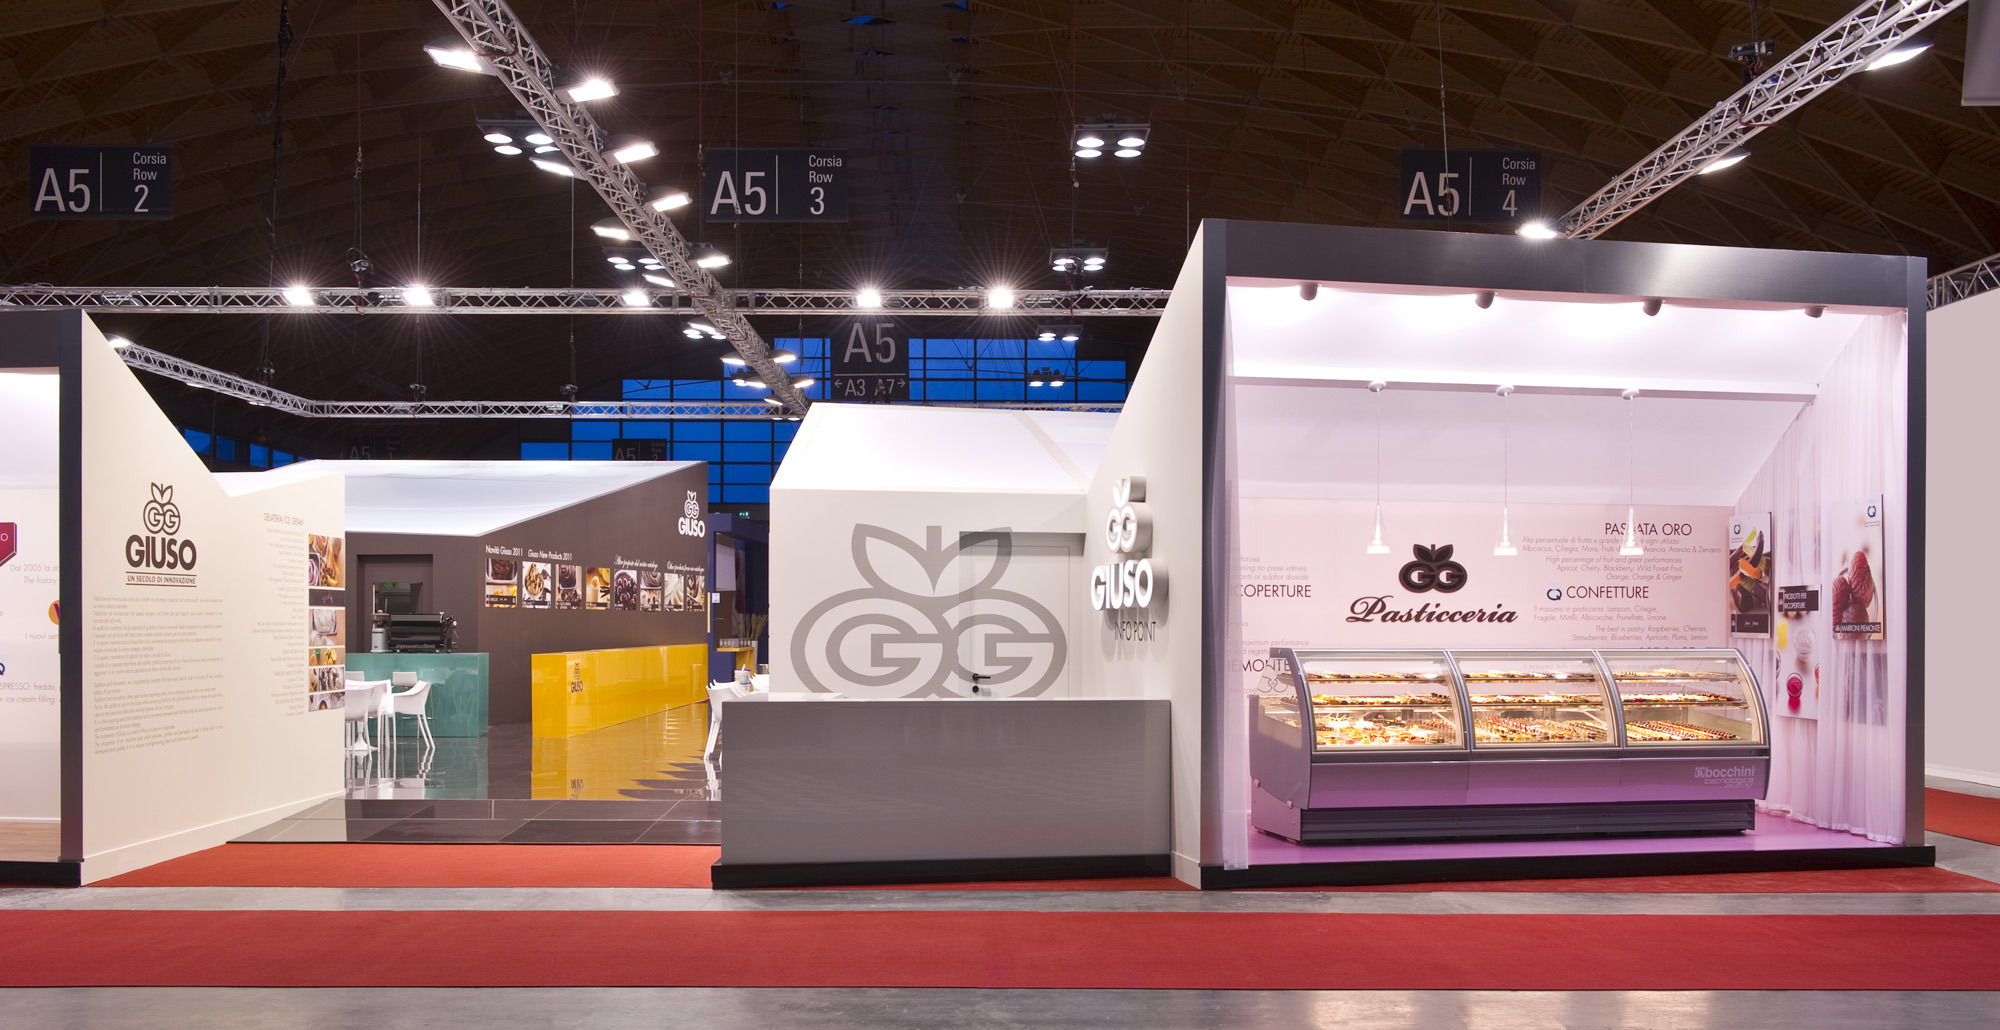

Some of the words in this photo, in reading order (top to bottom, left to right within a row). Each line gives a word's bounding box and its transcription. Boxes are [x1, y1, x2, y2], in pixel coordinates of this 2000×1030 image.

[133, 152, 167, 165] Corsia
[809, 155, 842, 167] Corsia
[1502, 157, 1536, 170] Corsia
[133, 168, 158, 181] Row
[809, 171, 833, 183] Row
[1502, 173, 1526, 186] Row
[34, 168, 91, 212] A5
[710, 171, 767, 215] A5
[1403, 171, 1460, 216] A5
[134, 184, 149, 212] 2
[810, 187, 825, 215] 3
[1502, 190, 1518, 217] 4
[843, 323, 896, 363] A5
[845, 379, 866, 396] A3
[874, 379, 895, 396] A7
[678, 517, 705, 538] GIUSO
[1605, 522, 1658, 535] PASATA
[1662, 523, 1692, 536] ORO
[1535, 536, 1568, 545] percentuale
[1599, 537, 1620, 545] grande
[1646, 537, 1659, 545] ogni
[125, 534, 197, 571] GIUSO
[512, 547, 523, 557] 2011
[563, 552, 573, 561] 2011
[1698, 546, 1721, 554] Zenzero
[1546, 556, 1560, 564] High
[1595, 555, 1602, 563] of
[1643, 556, 1681, 565] performances
[10, 563, 22, 572] Dal
[23, 563, 42, 572] 2005
[24, 576, 35, 584] The
[36, 576, 57, 585] history
[136, 575, 156, 583] SECOLO
[1632, 573, 1654, 582] Orange
[1662, 573, 1682, 582] Ginger
[1090, 558, 1154, 611] GIUSO
[1566, 586, 1649, 599] CONFETTURE
[1345, 595, 1518, 623] Pasticceria
[1539, 605, 1564, 613] massimo
[1565, 605, 1571, 613] in
[29, 632, 46, 640] nuovi
[1114, 621, 1133, 641] INFO
[1133, 621, 1156, 642] POINT
[571, 681, 583, 693] GIUSO
[1705, 766, 1755, 778] bocchini
